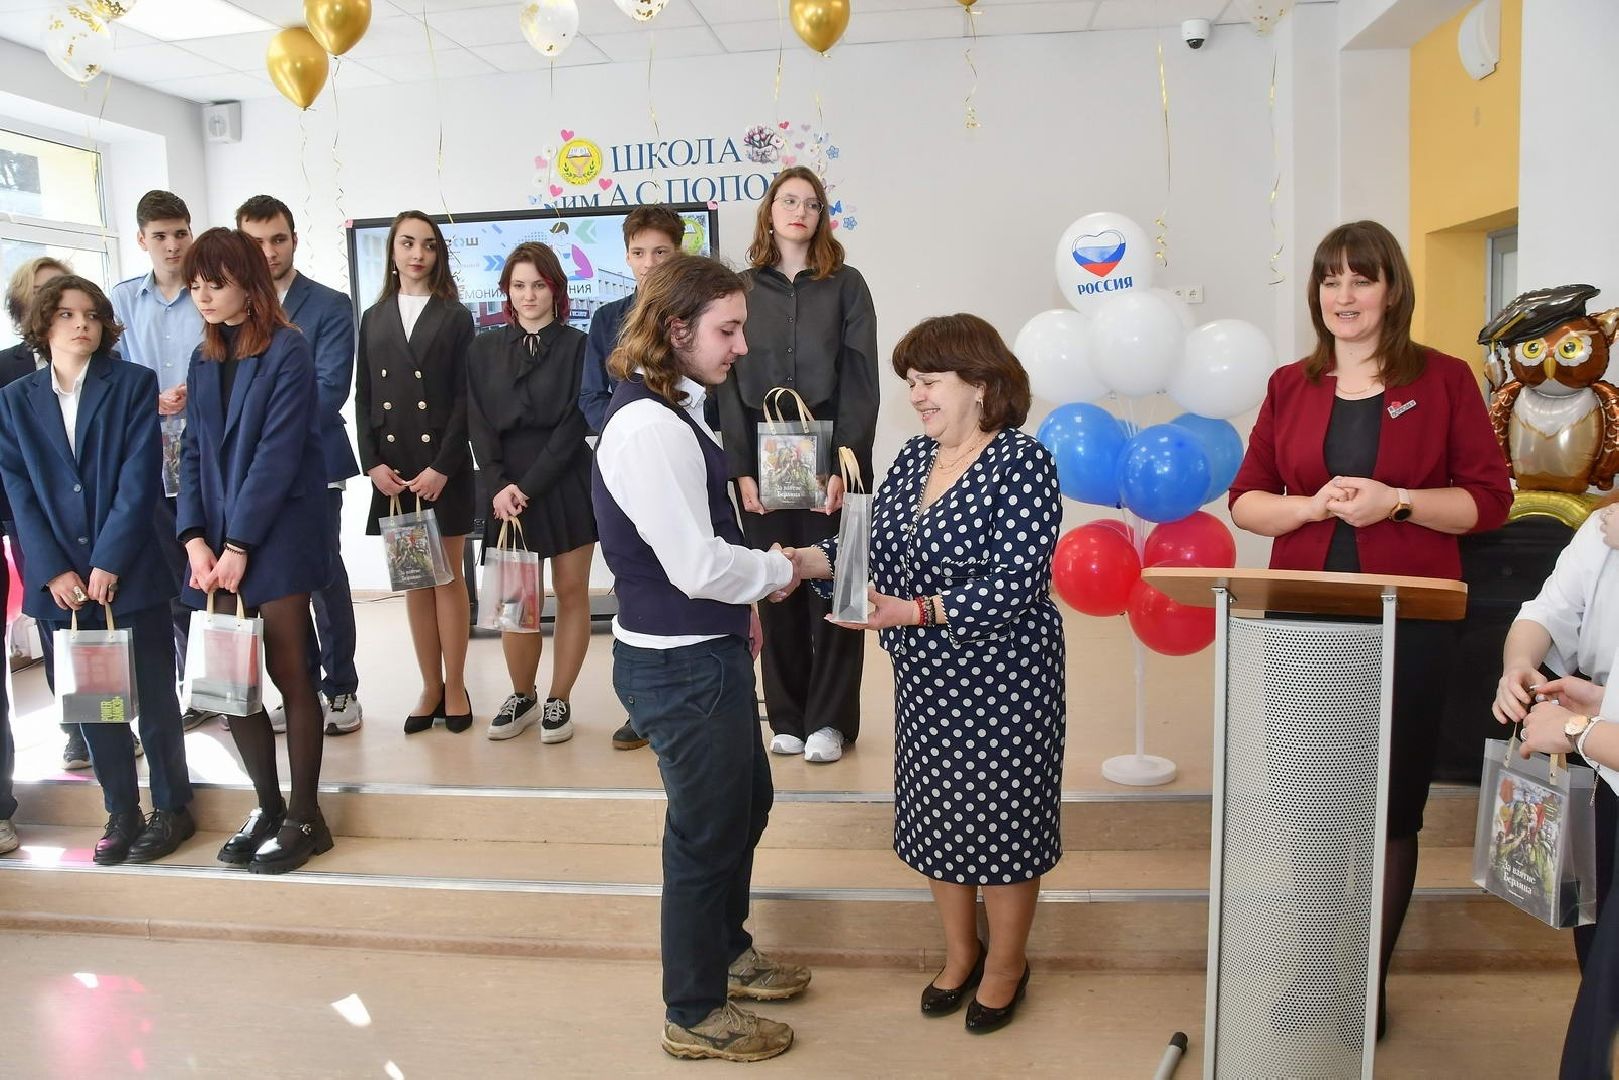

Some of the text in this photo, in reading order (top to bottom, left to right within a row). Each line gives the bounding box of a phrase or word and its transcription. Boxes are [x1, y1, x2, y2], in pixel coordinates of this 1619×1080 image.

[611, 136, 743, 173] ШКОЛА
[665, 172, 781, 204] ПОПО
[568, 283, 592, 294] НИЯ
[1077, 276, 1134, 295] РОССИЯ
